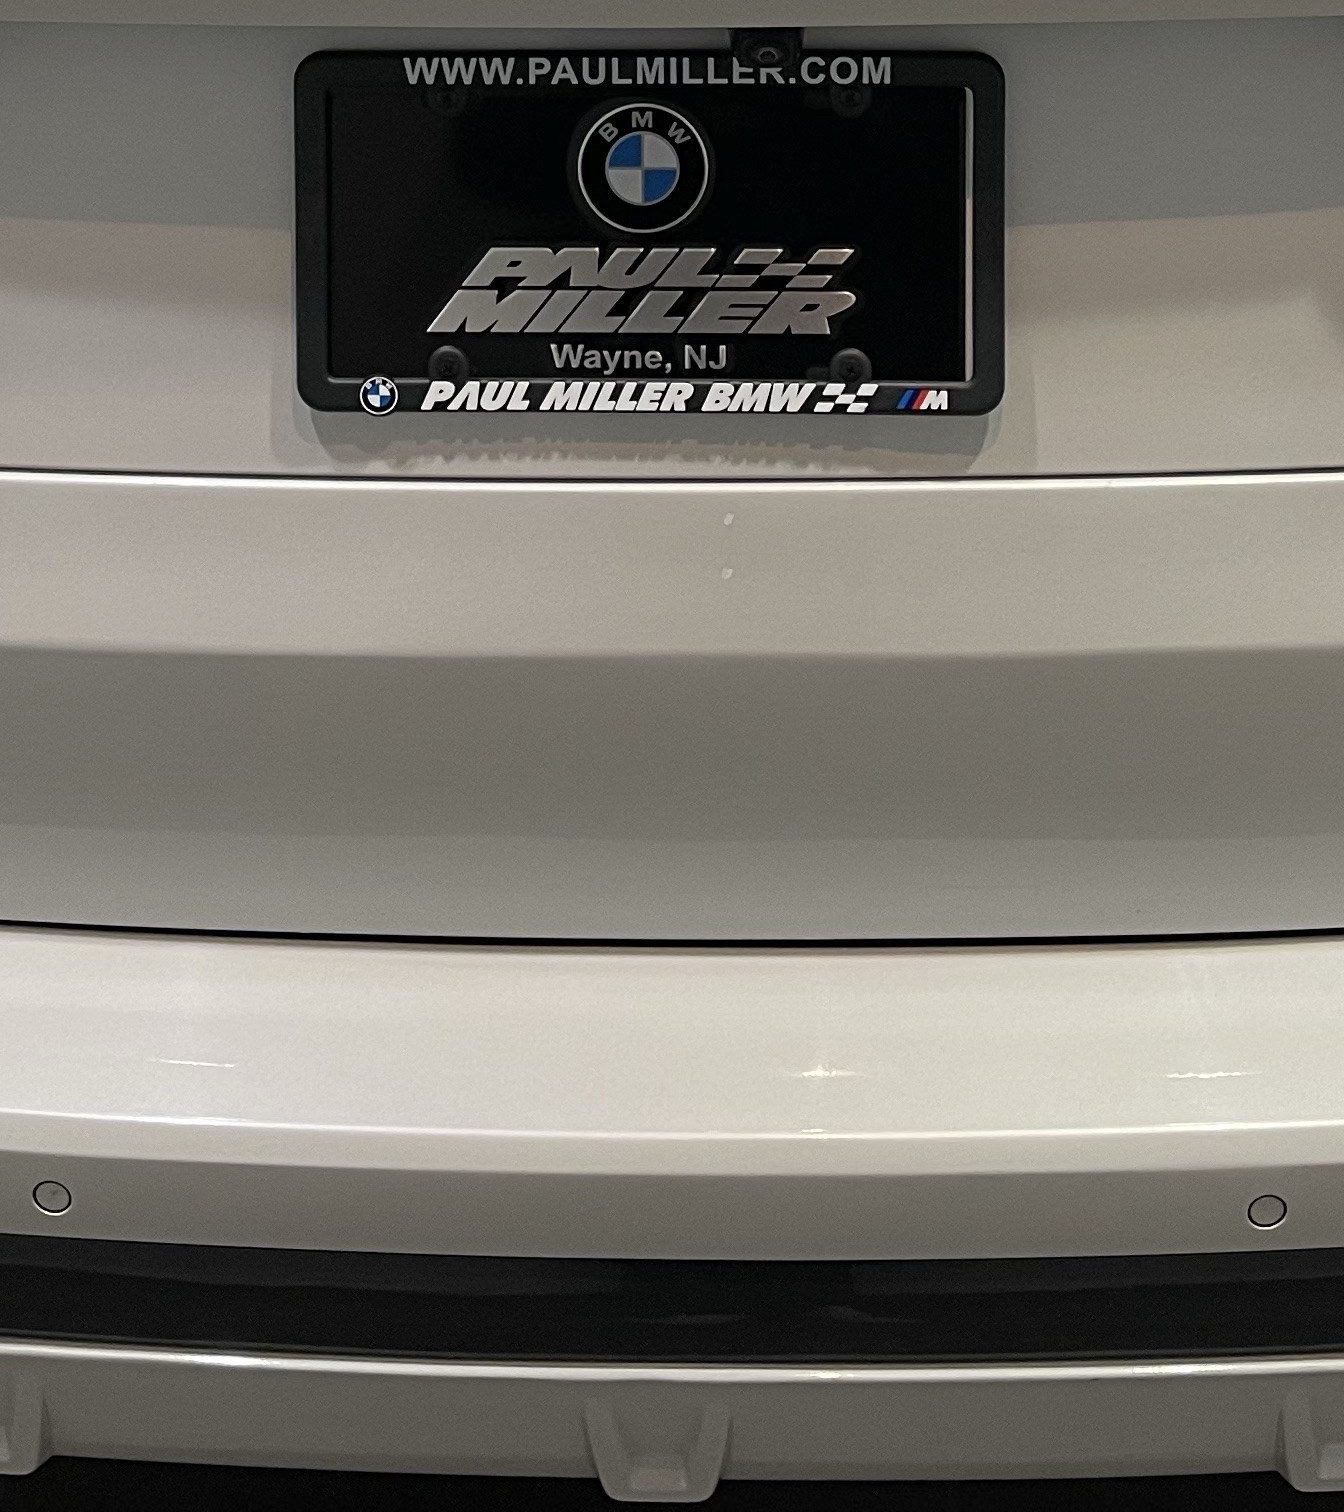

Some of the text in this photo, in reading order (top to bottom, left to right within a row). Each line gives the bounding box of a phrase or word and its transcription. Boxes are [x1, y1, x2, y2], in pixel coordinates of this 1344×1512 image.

[402, 56, 892, 86] WWW.PAULMILLER.COM
[597, 110, 691, 145] BMW
[461, 246, 720, 288] PAUL
[426, 288, 857, 335] MILLER
[550, 343, 728, 375] Wayne, NJ
[420, 380, 817, 413] PAUL MILLER BMW
